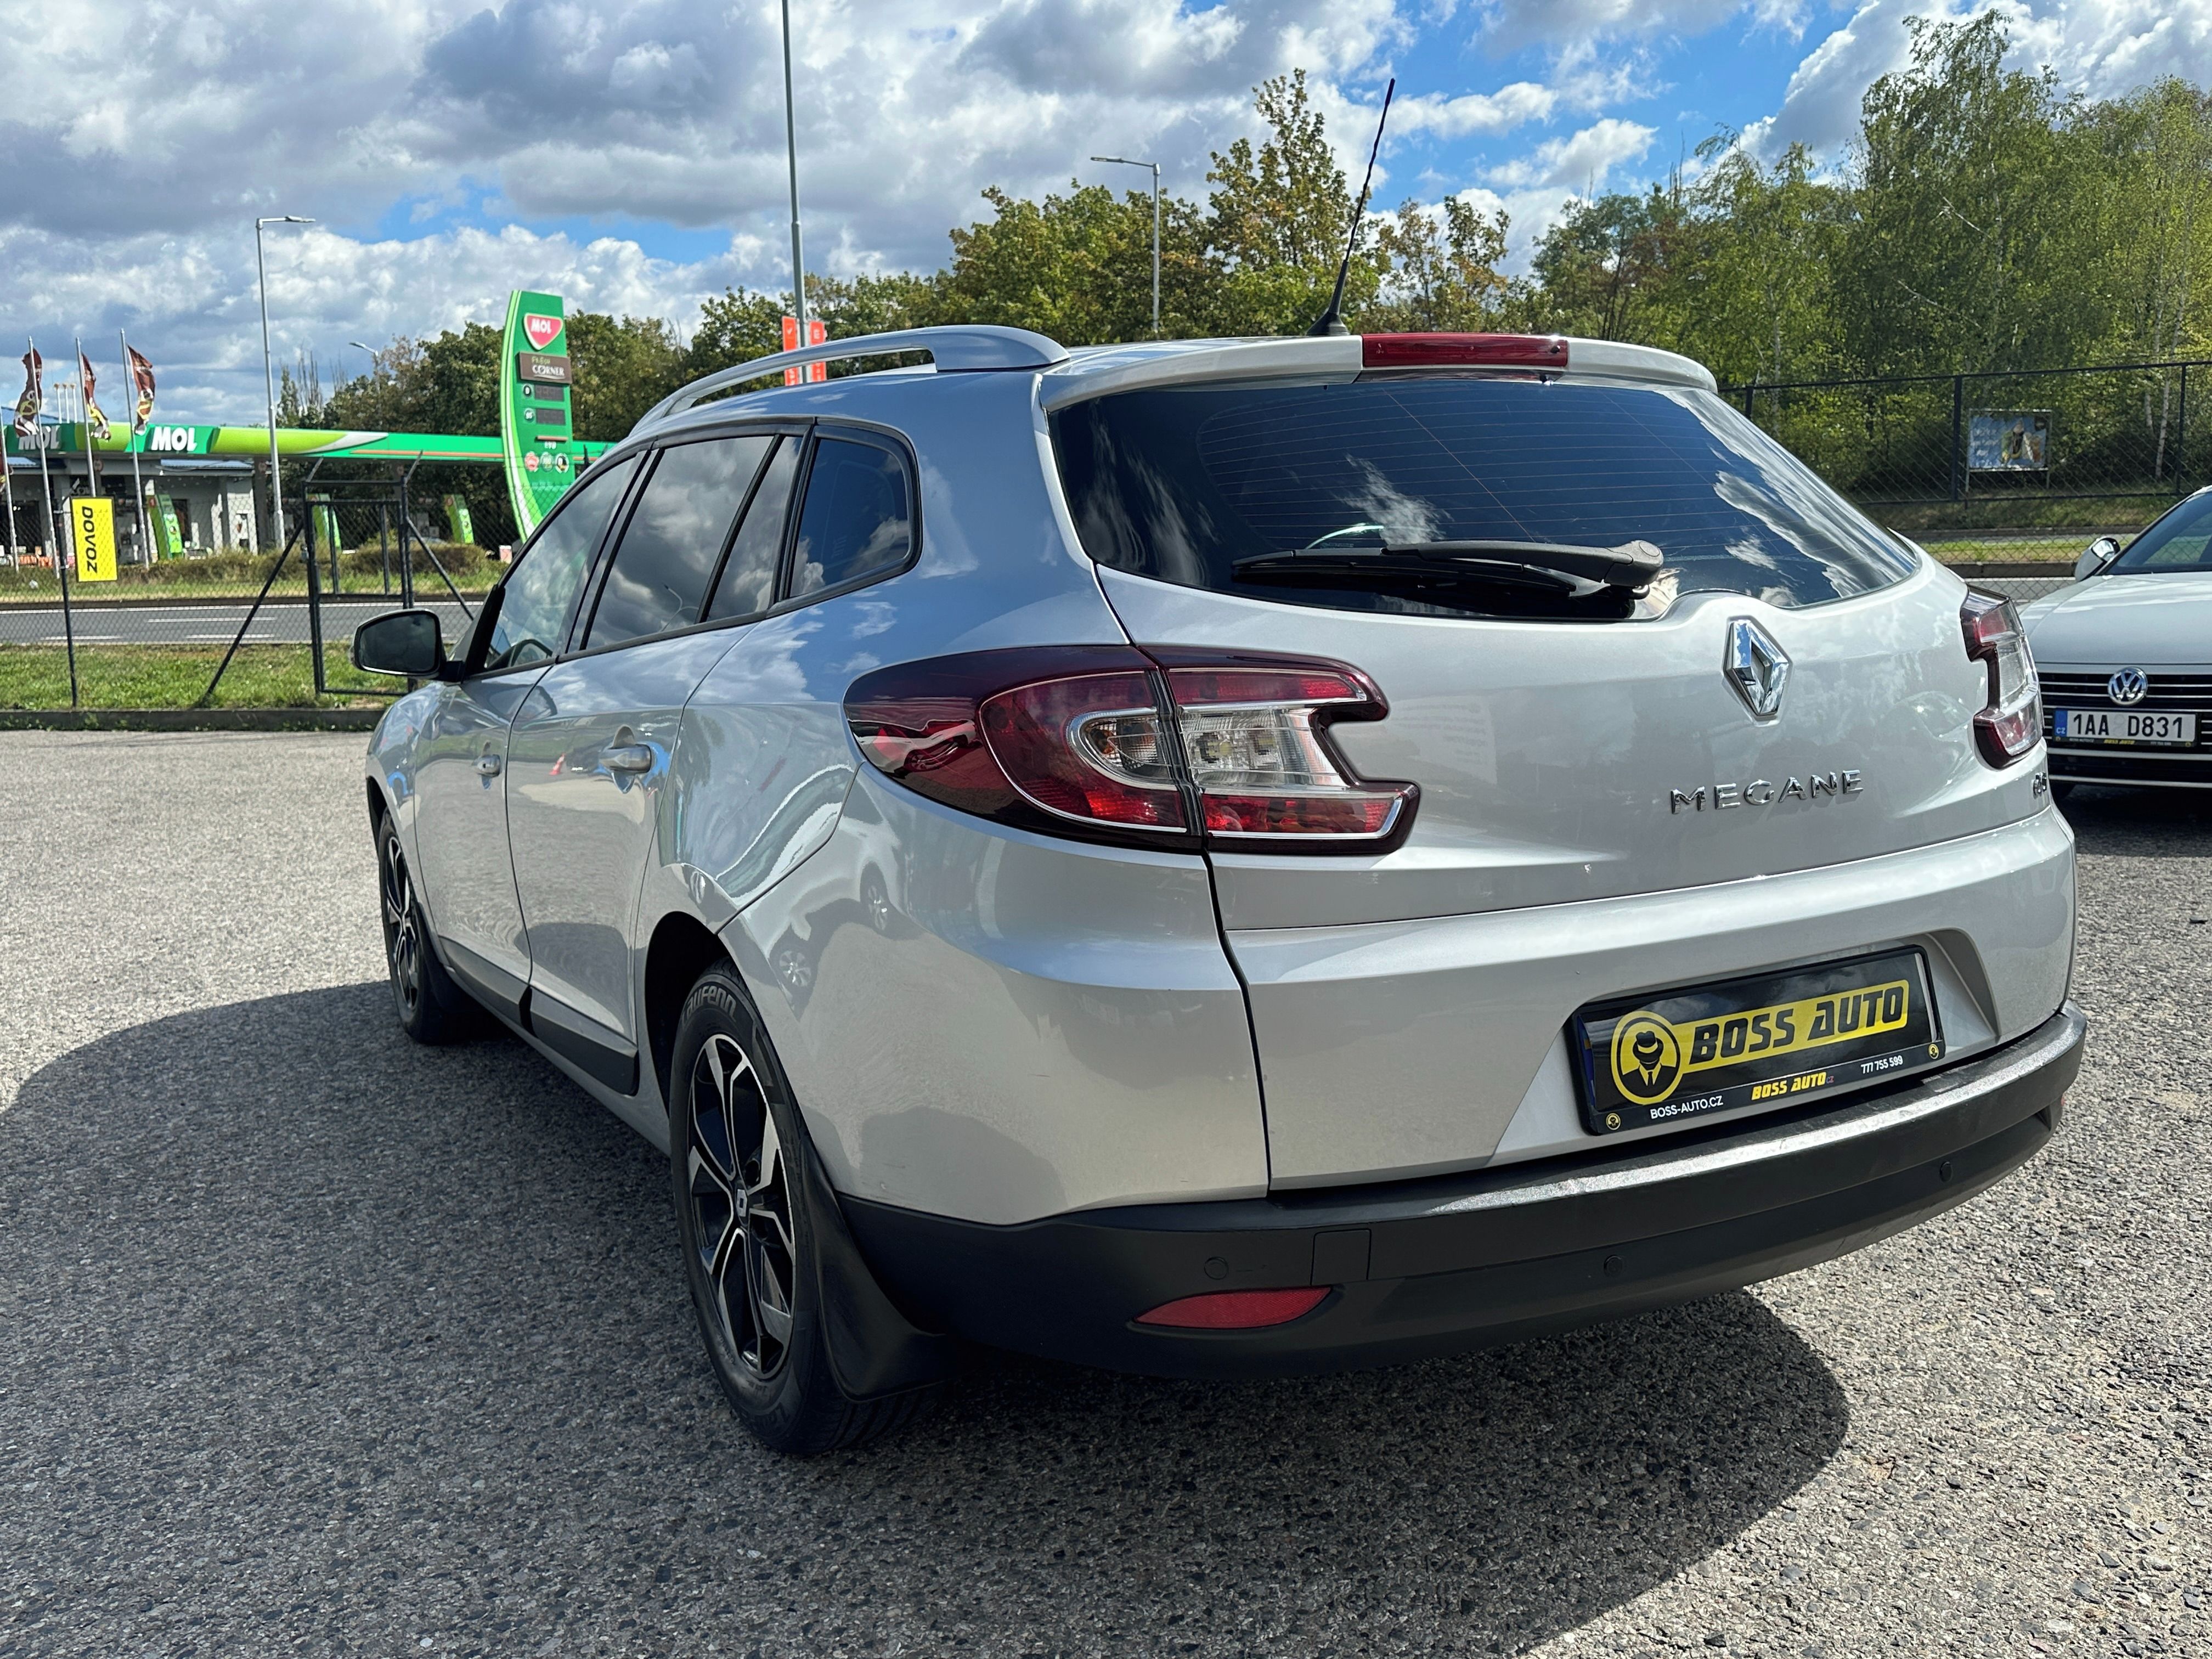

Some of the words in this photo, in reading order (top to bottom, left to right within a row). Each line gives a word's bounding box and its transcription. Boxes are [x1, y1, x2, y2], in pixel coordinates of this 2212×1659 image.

[531, 318, 552, 334] MOL
[532, 364, 565, 376] CORNER
[18, 425, 61, 450] MOL
[151, 426, 198, 452] MOL
[81, 506, 98, 574] DOVOZ
[2073, 714, 2109, 736] 1AA
[2127, 715, 2182, 738] D831
[1671, 769, 1864, 814] MEGANE
[1689, 1008, 1795, 1064] BOSS
[1807, 986, 1904, 1041] AUTO
[1860, 1062, 1874, 1074] 777
[1874, 1058, 1888, 1070] 755
[1889, 1055, 1903, 1067] 599
[1751, 1080, 1787, 1101] BOSS
[1790, 1071, 1826, 1092] AUTO
[1650, 1096, 1724, 1119] BOSS-AUTO.CZ
